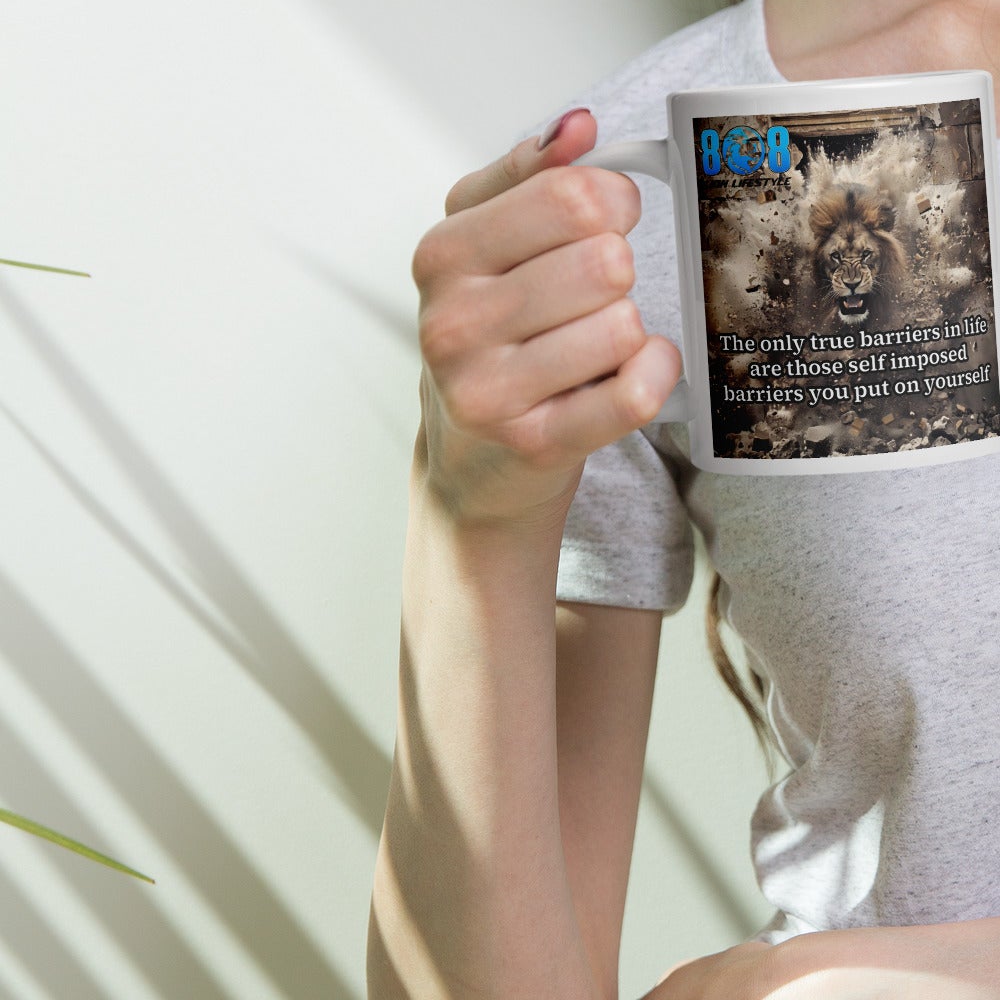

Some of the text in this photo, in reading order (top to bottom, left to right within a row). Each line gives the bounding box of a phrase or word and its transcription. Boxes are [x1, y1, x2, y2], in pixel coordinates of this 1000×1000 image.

[731, 176, 792, 188] LIFESTYLE
[719, 316, 988, 356] The only true barriers in life
[749, 343, 968, 377] are those self imposed
[723, 364, 992, 406] barriers you put on yourself
